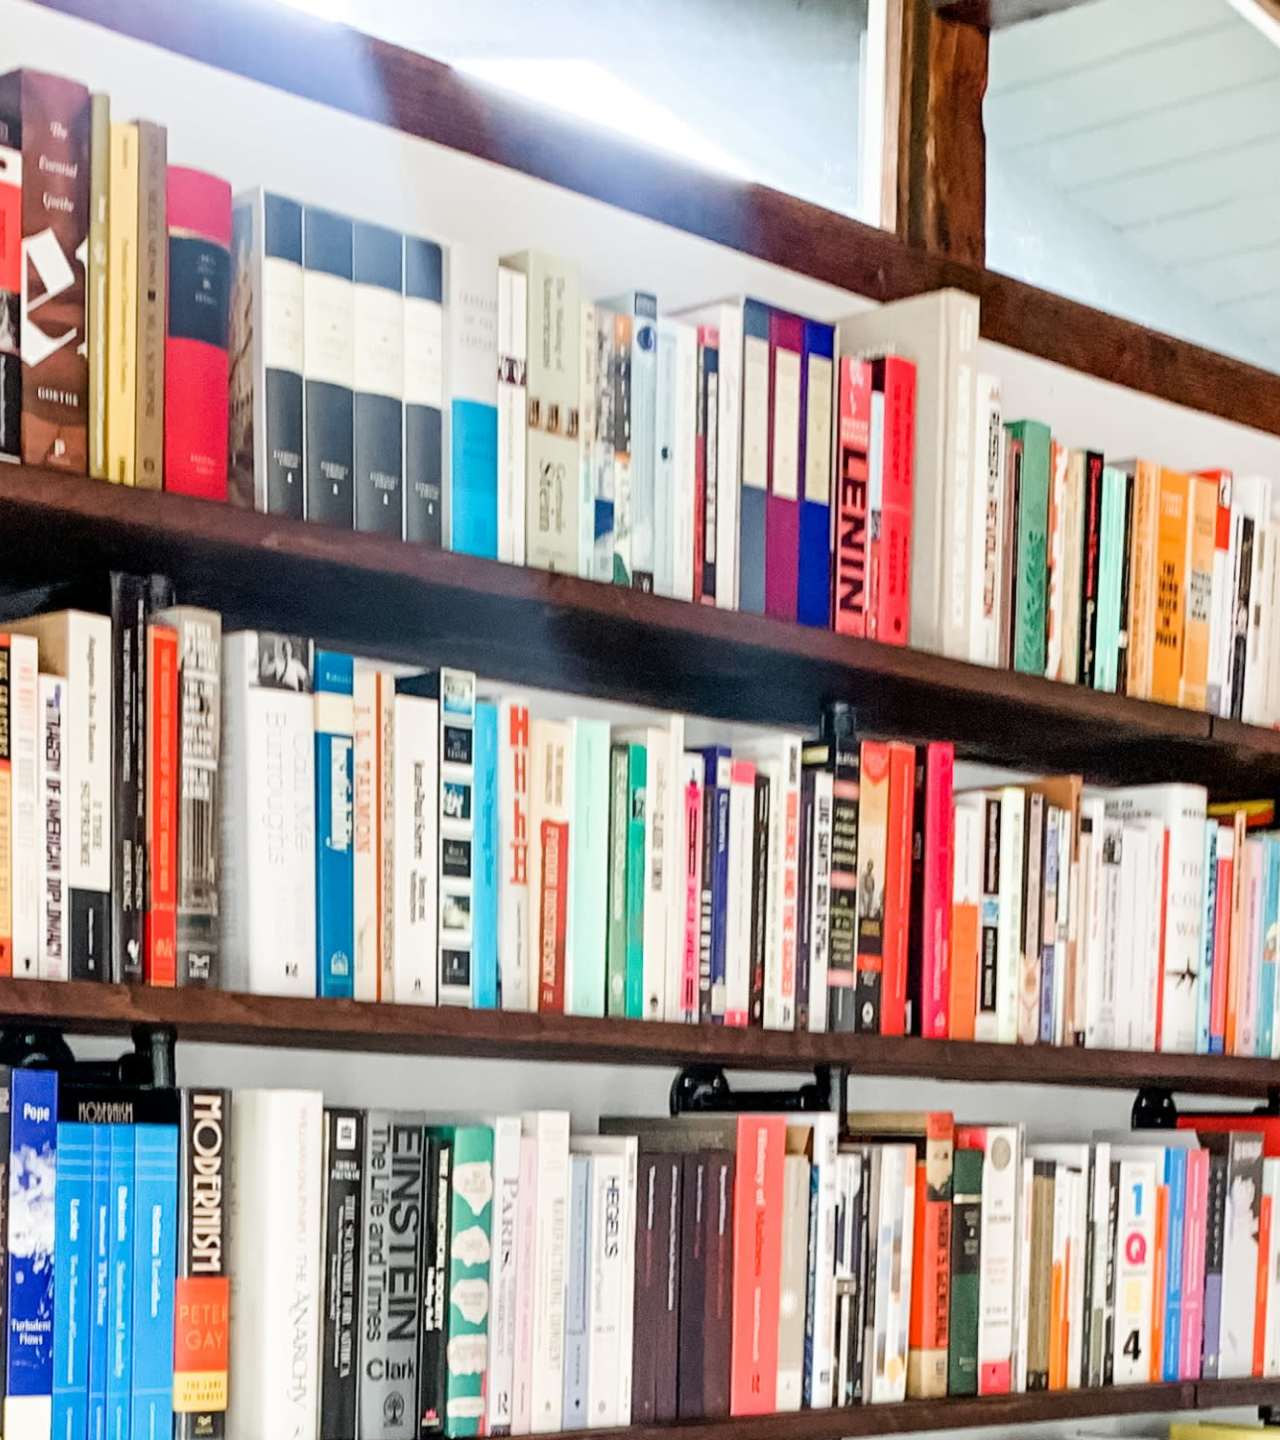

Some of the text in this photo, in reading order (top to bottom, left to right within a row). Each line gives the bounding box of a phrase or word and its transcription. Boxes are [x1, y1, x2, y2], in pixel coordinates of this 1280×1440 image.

[49, 120, 68, 139] The
[841, 447, 868, 613] LENIN
[45, 798, 63, 872] AMERICAN
[79, 781, 92, 867] SUPREME
[23, 1103, 50, 1123] Pope
[78, 1102, 134, 1123] MODERNISM
[190, 1093, 222, 1273] MODERNISM
[366, 1124, 388, 1342] The Life and Times
[387, 1125, 421, 1342] EINSTEIN
[10, 1317, 52, 1334] Turbulent
[18, 1332, 44, 1346] Flows
[185, 1331, 225, 1351] GAY
[365, 1357, 417, 1382] Clark
